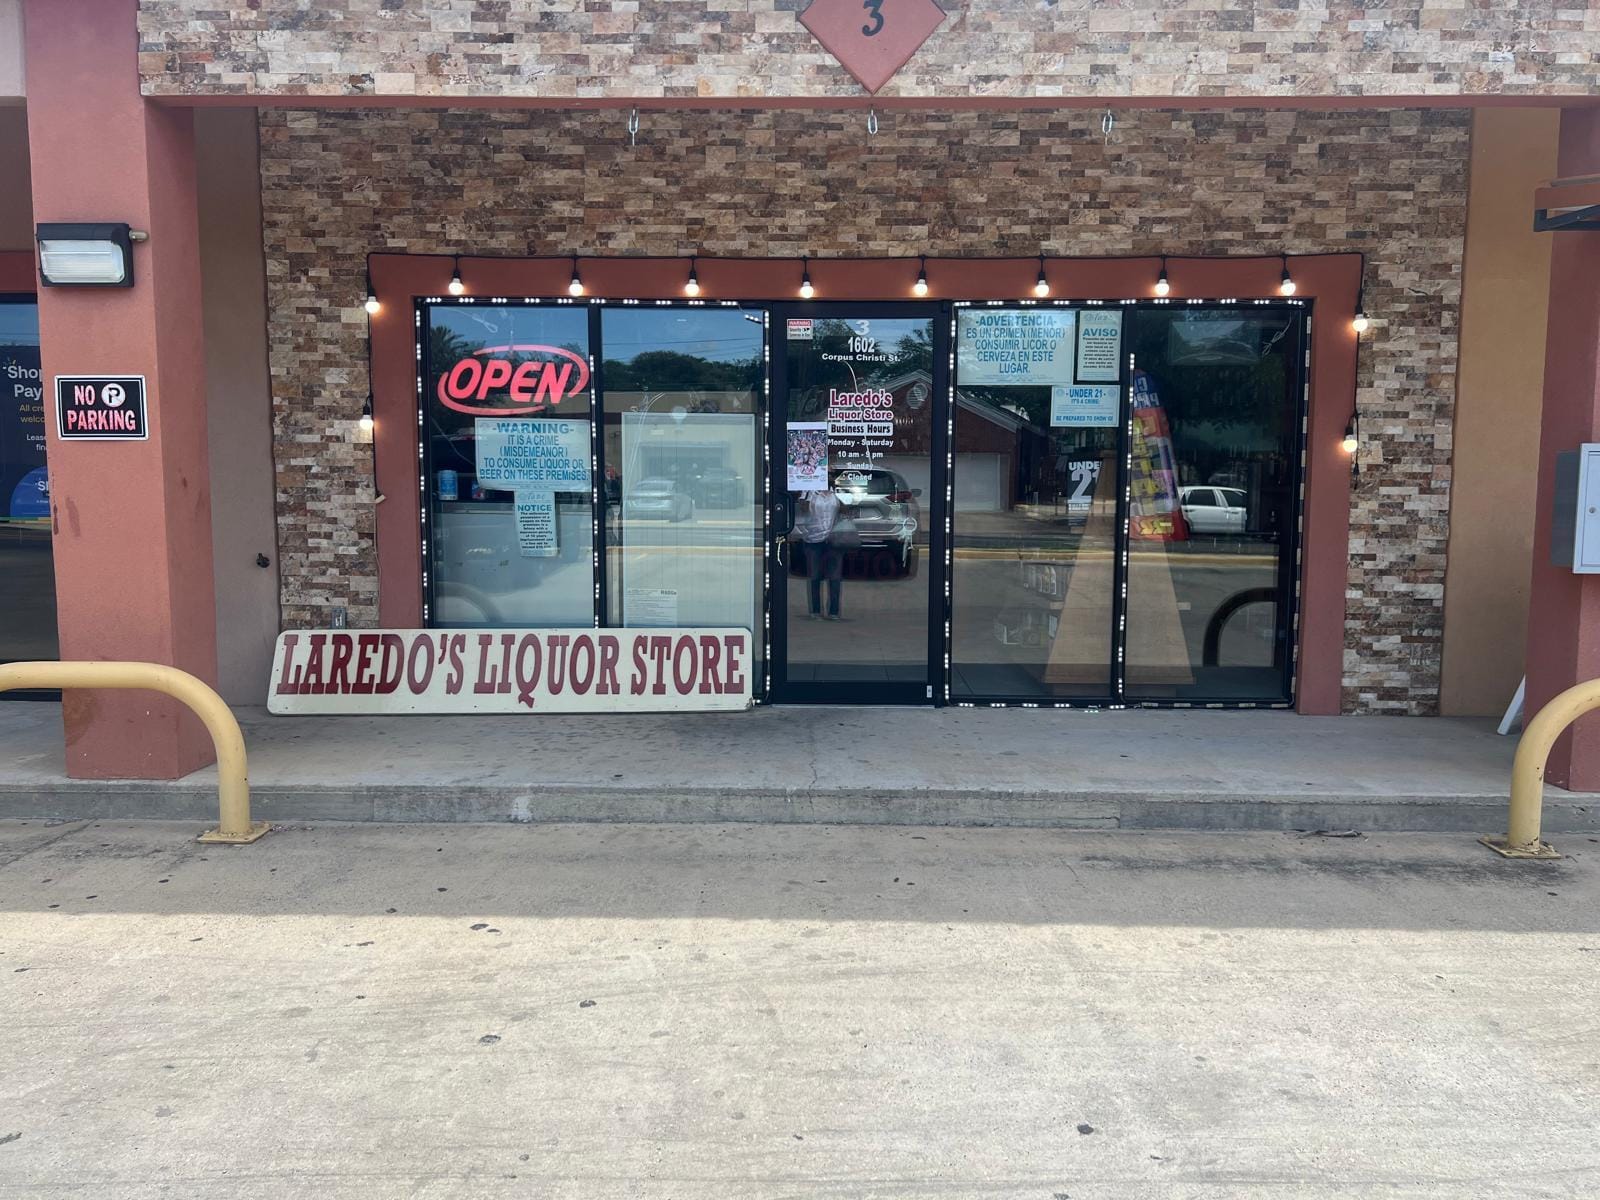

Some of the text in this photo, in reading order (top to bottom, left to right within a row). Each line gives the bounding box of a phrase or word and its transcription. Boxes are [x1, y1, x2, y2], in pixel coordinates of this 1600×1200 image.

[861, 0, 884, 37] 3
[854, 319, 870, 336] 3
[966, 327, 1066, 339] ES UN CRIMEN (MENOR)
[1082, 328, 1118, 337] AVISO
[847, 336, 876, 353] 1602
[974, 339, 1057, 350] CONSUMIR LICOR O
[821, 353, 901, 362] Corpus Christi St.
[977, 351, 1054, 362] CERVEZA EN ESTE
[999, 362, 1031, 374] LUGAR.
[447, 358, 574, 404] OPEN
[14, 384, 43, 401] Pay
[74, 385, 96, 406] NO
[829, 388, 894, 408] Laredo's
[1069, 388, 1103, 398] UNDER 21
[20, 404, 30, 412] All
[66, 410, 137, 431] PARKING
[827, 408, 863, 423] Liquor
[863, 408, 894, 421] Store
[831, 424, 891, 433] Business Hours
[508, 434, 561, 446] IT IS A CRIME
[827, 439, 856, 448] Monday
[861, 438, 894, 448] Saturday
[500, 446, 568, 457] (MISDEMEANOR)
[838, 450, 847, 458] 10
[872, 451, 884, 460] pm
[484, 458, 584, 469] TO CONSUME LIQUOR OR
[847, 461, 874, 471] Sunday
[1068, 460, 1104, 471] UNDE
[480, 469, 502, 480] BEER
[503, 469, 516, 480] ON
[517, 469, 544, 480] THESE
[847, 473, 873, 481] Closed
[517, 504, 553, 512] NOTICE
[276, 633, 745, 709] LAREDO'S LIQUOR STORE
